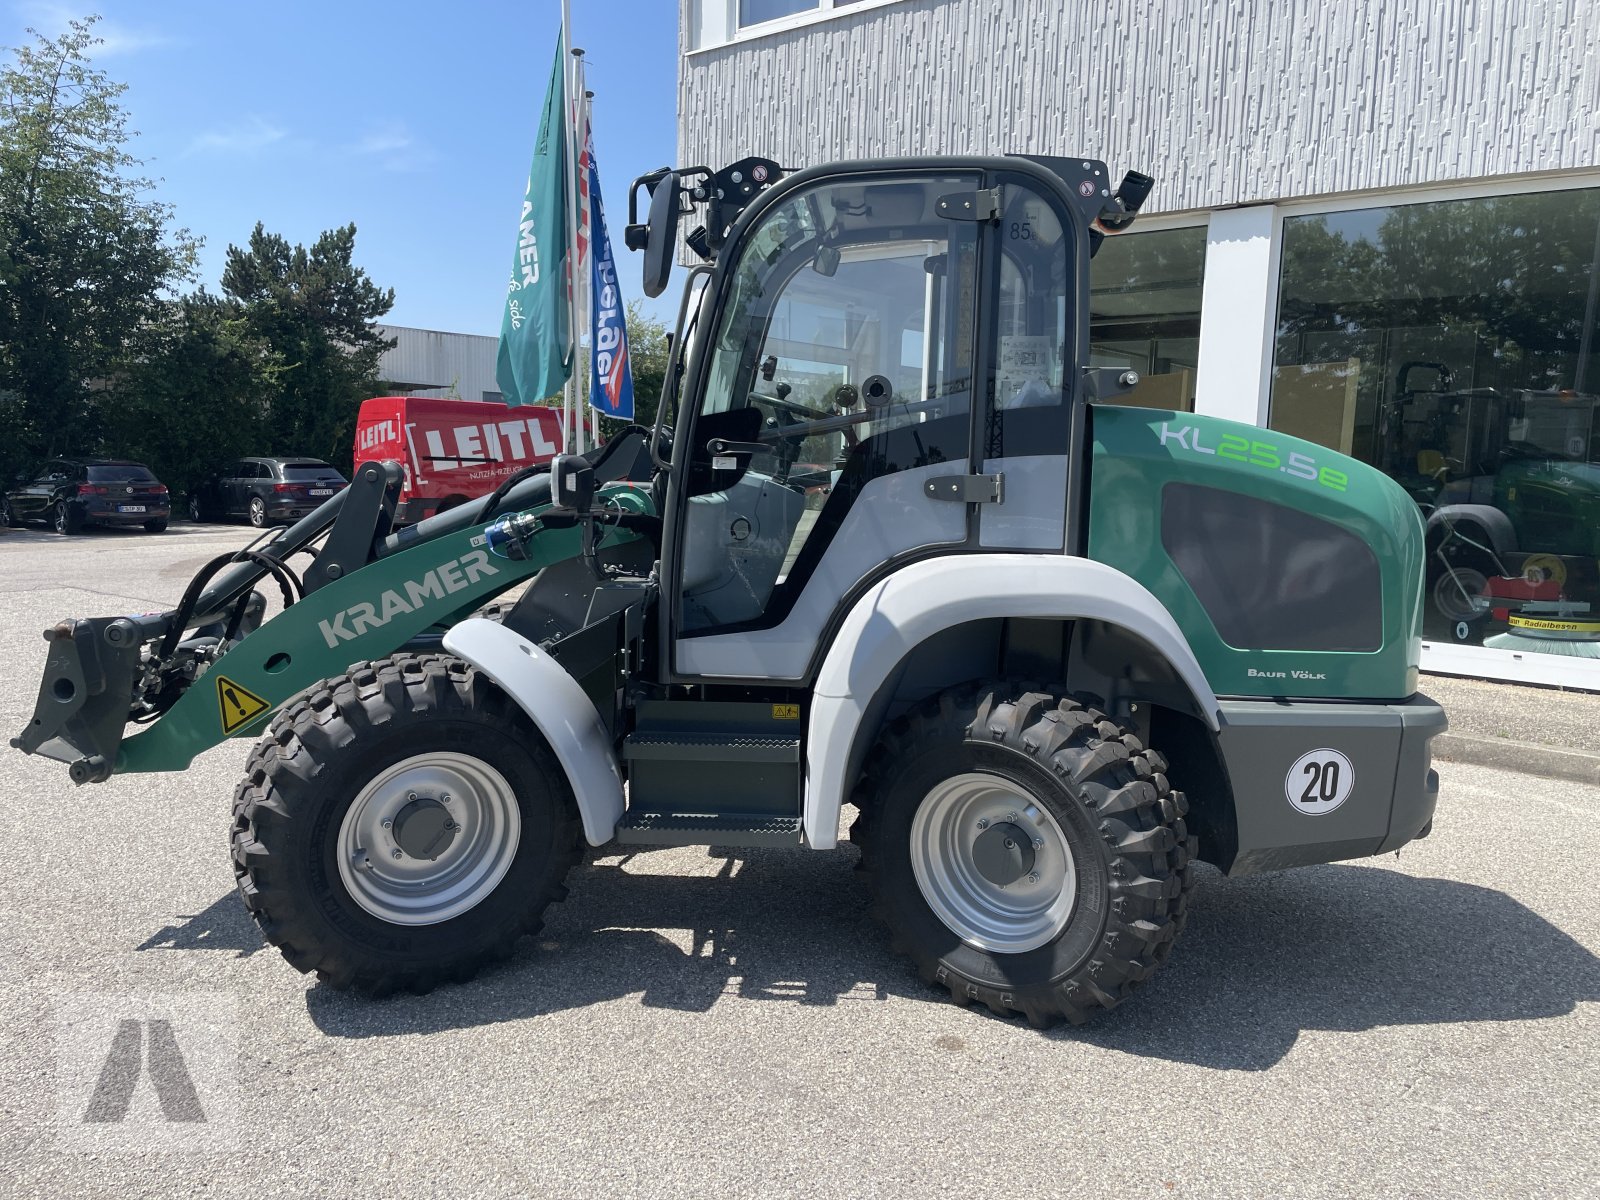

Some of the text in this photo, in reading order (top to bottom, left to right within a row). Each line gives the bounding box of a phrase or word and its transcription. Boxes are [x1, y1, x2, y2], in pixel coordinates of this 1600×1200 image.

[1010, 222, 1031, 240] 85
[508, 299, 526, 331] side
[361, 420, 396, 450] LEITL
[425, 418, 556, 472] LEITL
[1160, 422, 1348, 492] KL25.5e
[318, 550, 500, 649] KRAMER
[1524, 620, 1578, 630] Radialbesen
[1300, 760, 1340, 803] 20
